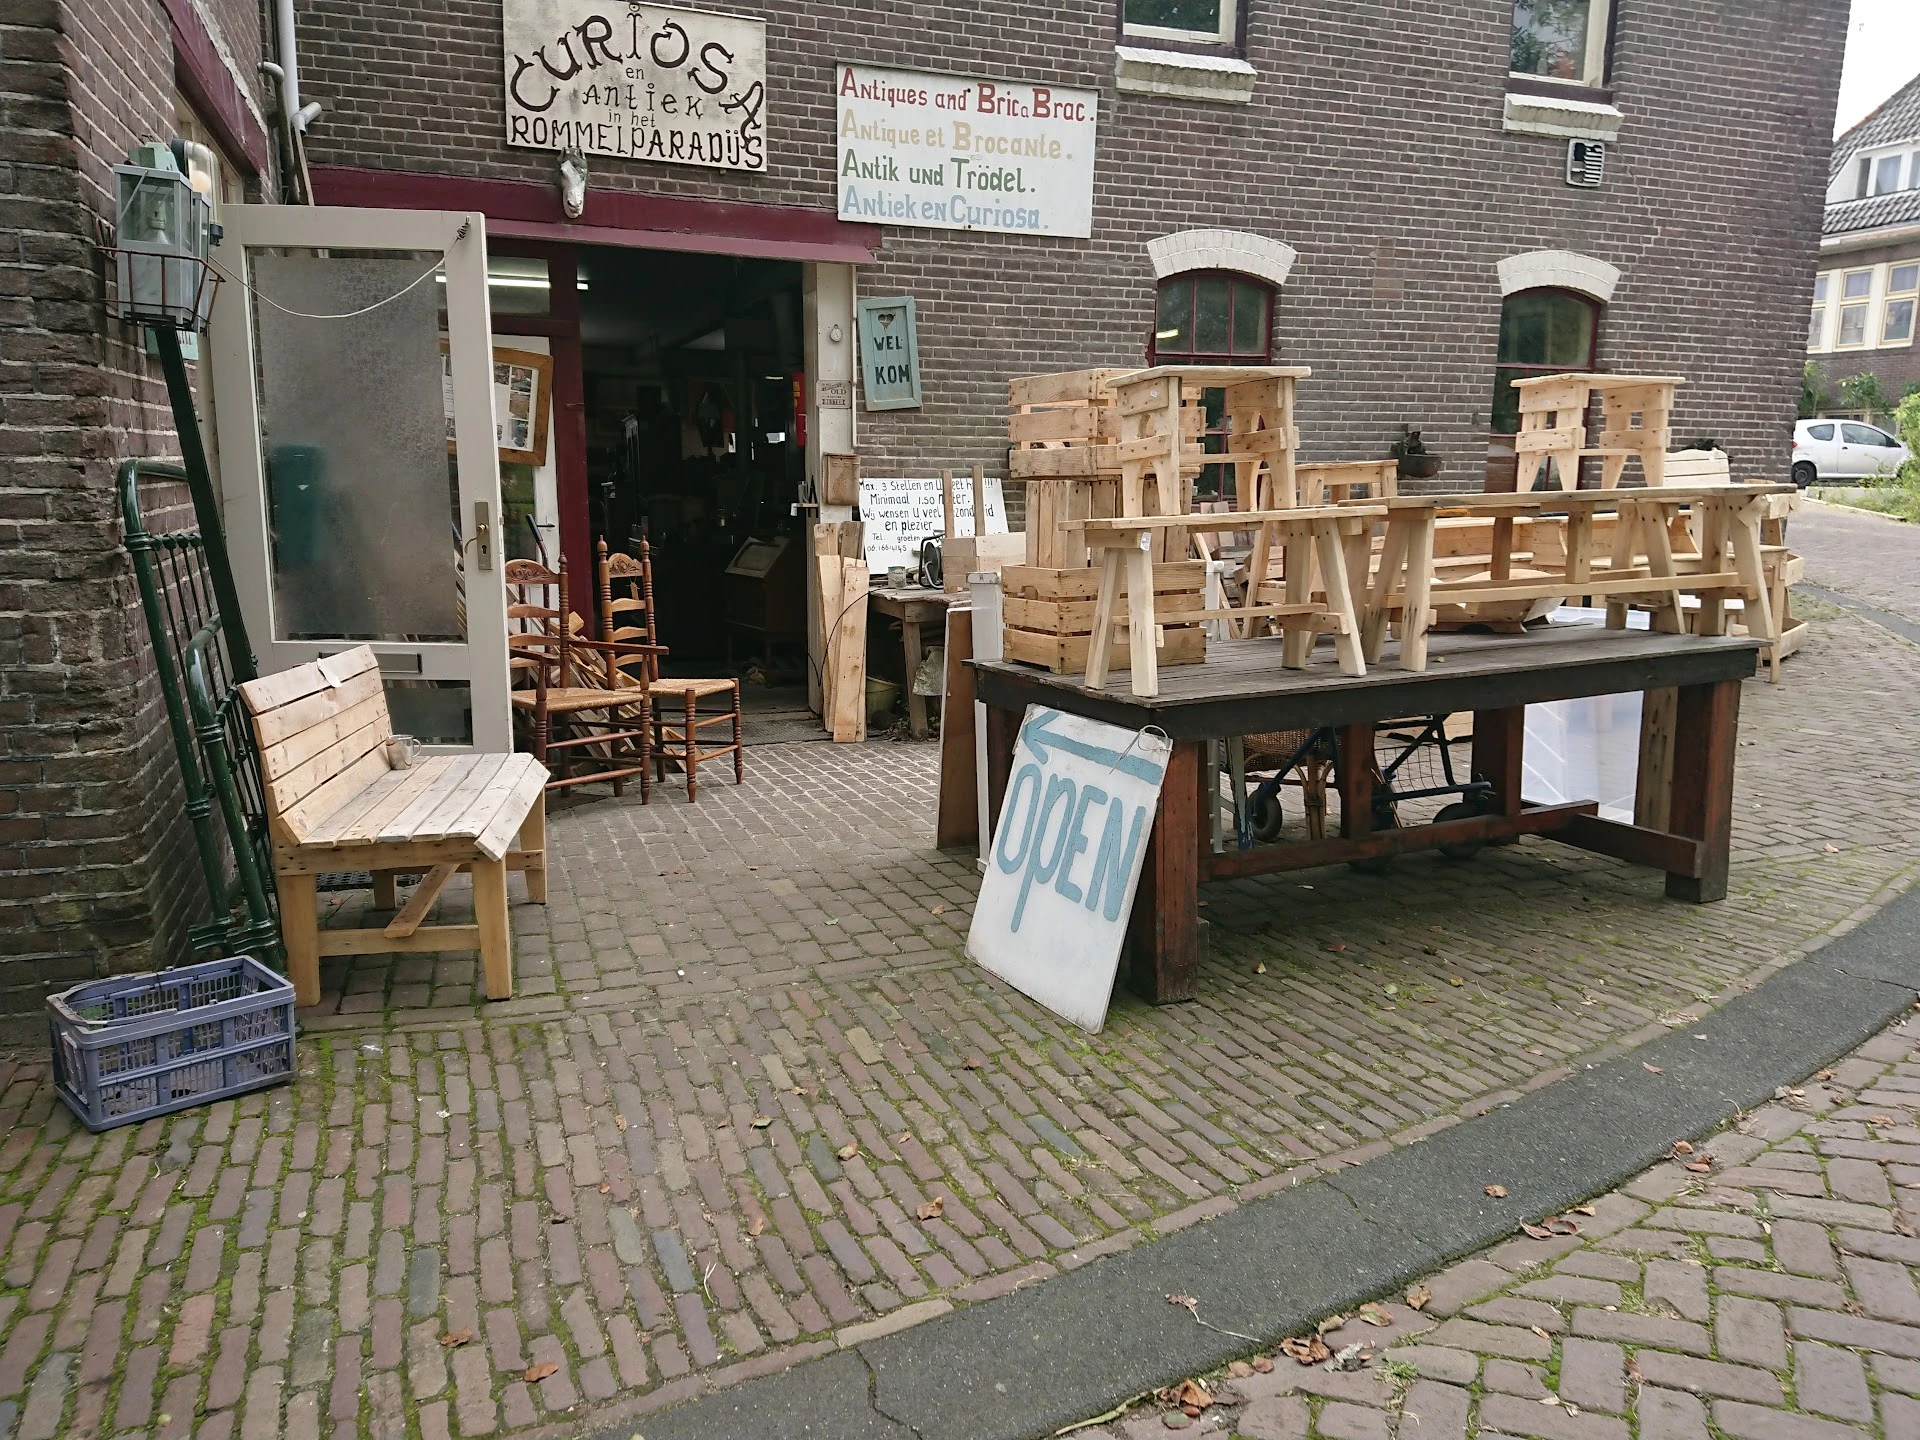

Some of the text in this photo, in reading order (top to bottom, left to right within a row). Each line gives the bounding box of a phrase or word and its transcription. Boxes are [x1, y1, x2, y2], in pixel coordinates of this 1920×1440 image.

[626, 66, 645, 80] en
[582, 82, 704, 119] Antiek
[839, 67, 928, 108] Antiques
[935, 89, 969, 111] and
[1032, 87, 1095, 122] Brac.
[608, 109, 657, 128] in het
[840, 108, 1073, 160] Antique et Brocante.
[841, 148, 1036, 193] Antik und Trödel.
[842, 185, 1049, 230] Antiek en Curiosa.
[873, 335, 903, 352] WEL
[875, 364, 911, 385] KOM
[881, 482, 888, 491] 3
[890, 480, 922, 491] Stellen
[924, 481, 934, 491] en
[870, 492, 910, 506] Minimaal
[918, 496, 936, 505] 1.50
[862, 507, 876, 521] Wij
[878, 509, 910, 519] wensen
[912, 507, 920, 519] U
[922, 506, 942, 519] veel
[884, 518, 933, 536] en plezier
[871, 532, 886, 541] Tel.
